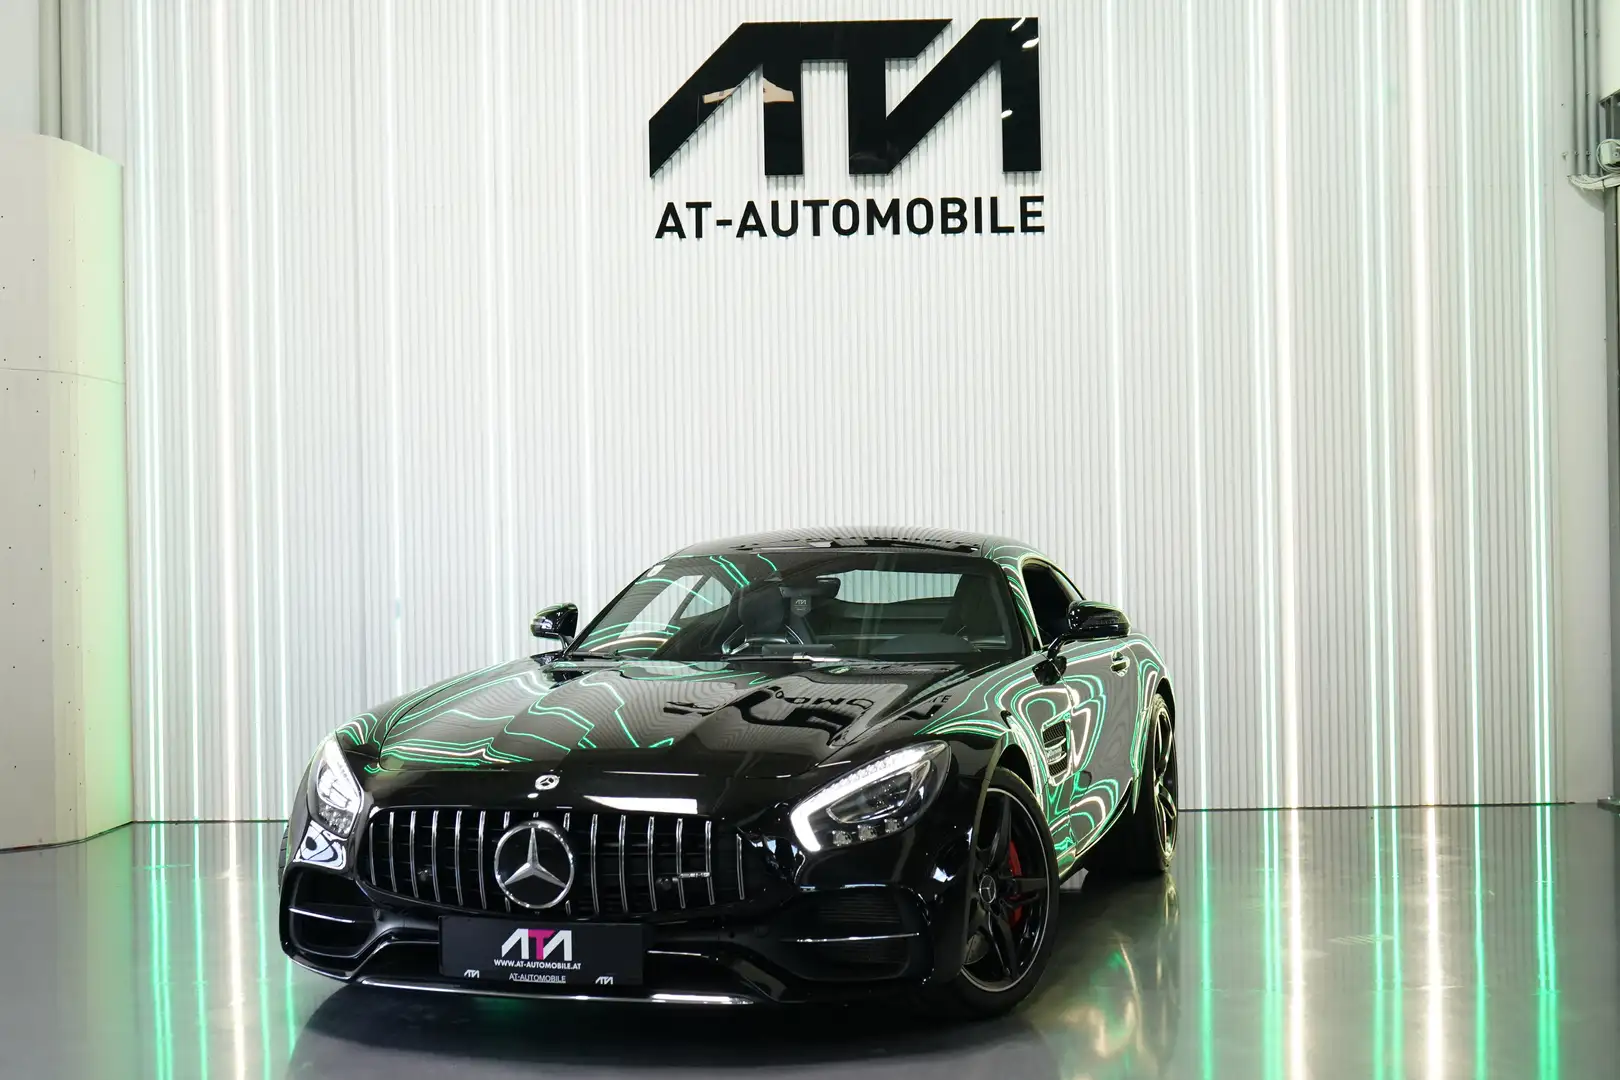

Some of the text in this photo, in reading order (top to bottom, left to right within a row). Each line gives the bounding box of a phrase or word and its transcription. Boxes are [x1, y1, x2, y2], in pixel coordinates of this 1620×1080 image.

[649, 17, 1041, 178] ATA
[655, 195, 1045, 239] AT-AUTOMOBILE
[501, 928, 573, 961] ATA
[493, 959, 581, 970] WWW.AT-AUTOMOBILE.AT
[508, 973, 567, 984] AT-AUTOMOBILE
